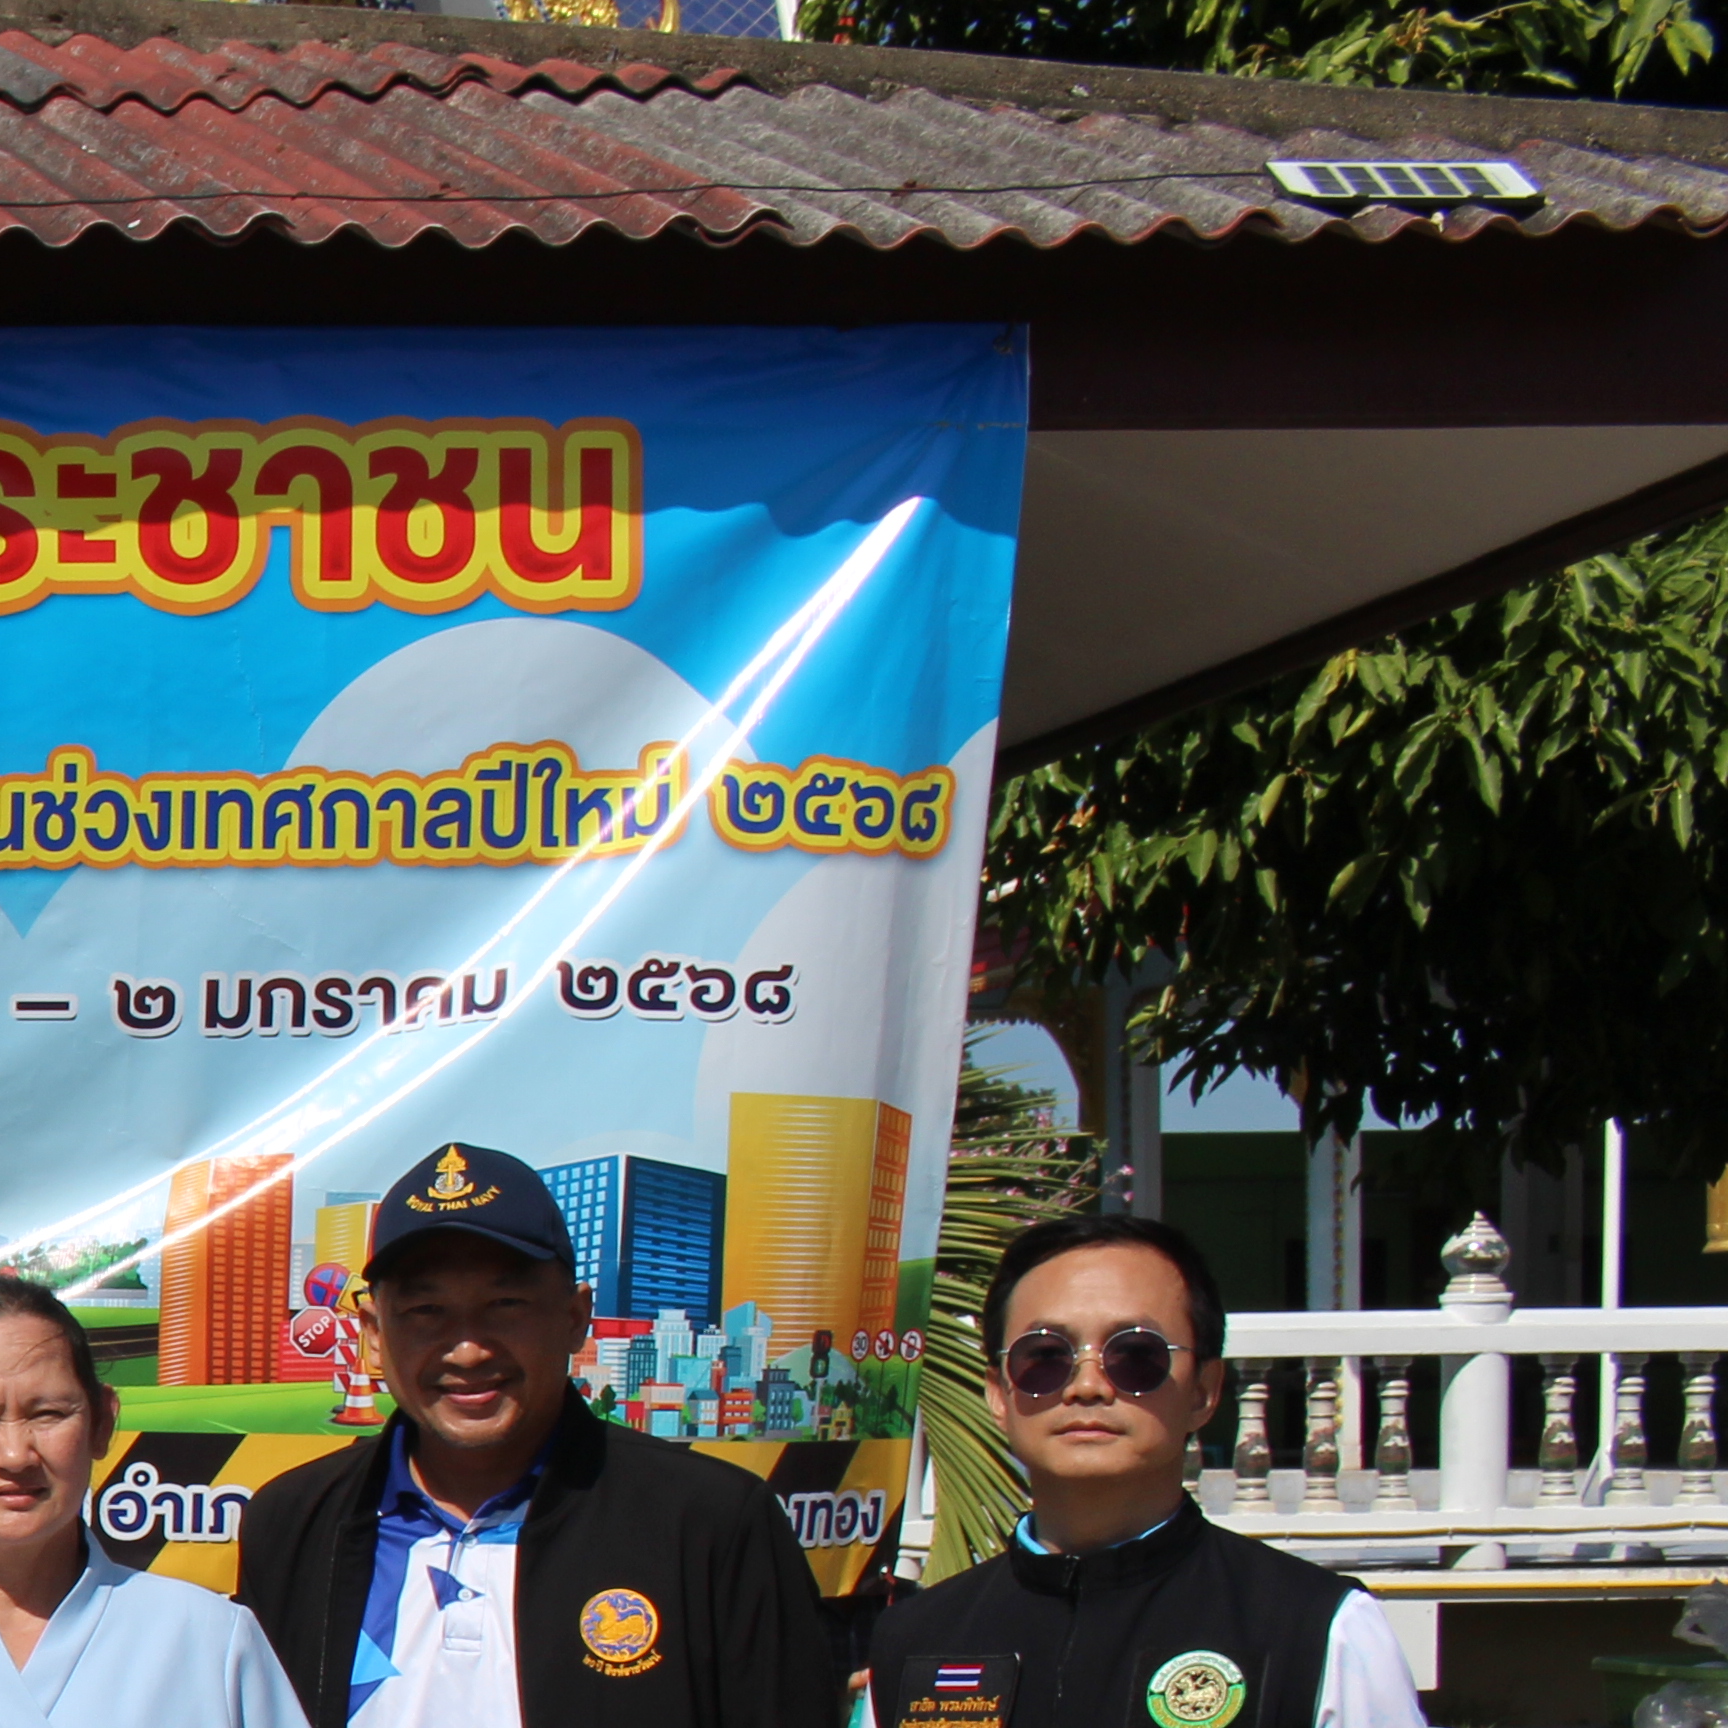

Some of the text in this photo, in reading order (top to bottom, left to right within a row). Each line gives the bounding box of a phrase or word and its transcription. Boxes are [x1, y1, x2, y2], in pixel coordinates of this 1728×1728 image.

[720, 768, 946, 846] ๒๕๖๘
[112, 975, 178, 1029] ๒
[203, 965, 507, 1030] มกราคม
[556, 954, 796, 1018] ๒๕๖๘
[438, 1199, 468, 1211] THAI
[470, 1185, 501, 1206] NAVY
[298, 1316, 331, 1347] STOP
